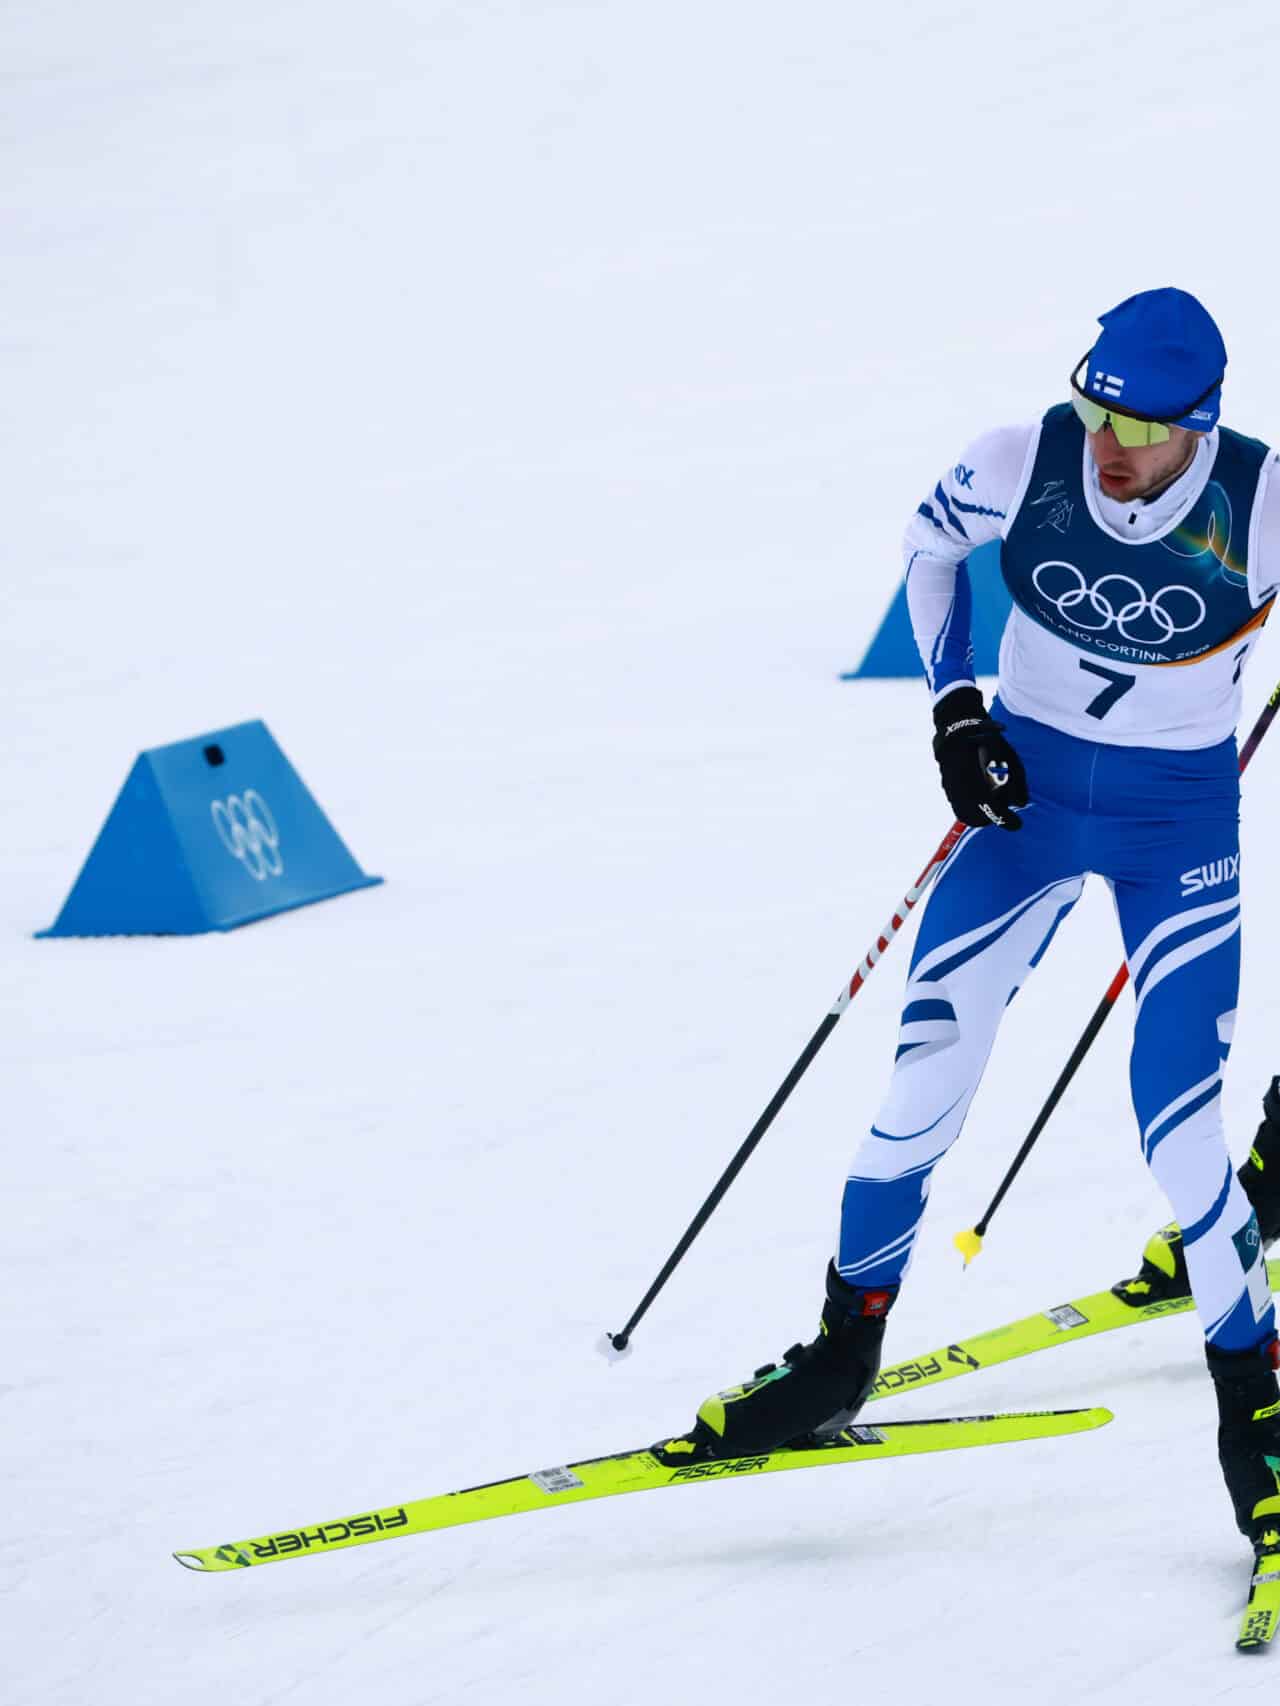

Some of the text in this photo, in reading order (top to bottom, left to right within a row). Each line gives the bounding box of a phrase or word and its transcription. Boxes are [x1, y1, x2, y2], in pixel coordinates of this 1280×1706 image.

[1036, 603, 1092, 643] MILANO
[1095, 638, 1172, 662] CORTINA
[1079, 657, 1137, 721] 7
[1180, 852, 1240, 897] SWIX
[872, 1357, 943, 1393] FISCH
[667, 1456, 770, 1482] FISCHER
[250, 1508, 408, 1558] FISCHER
